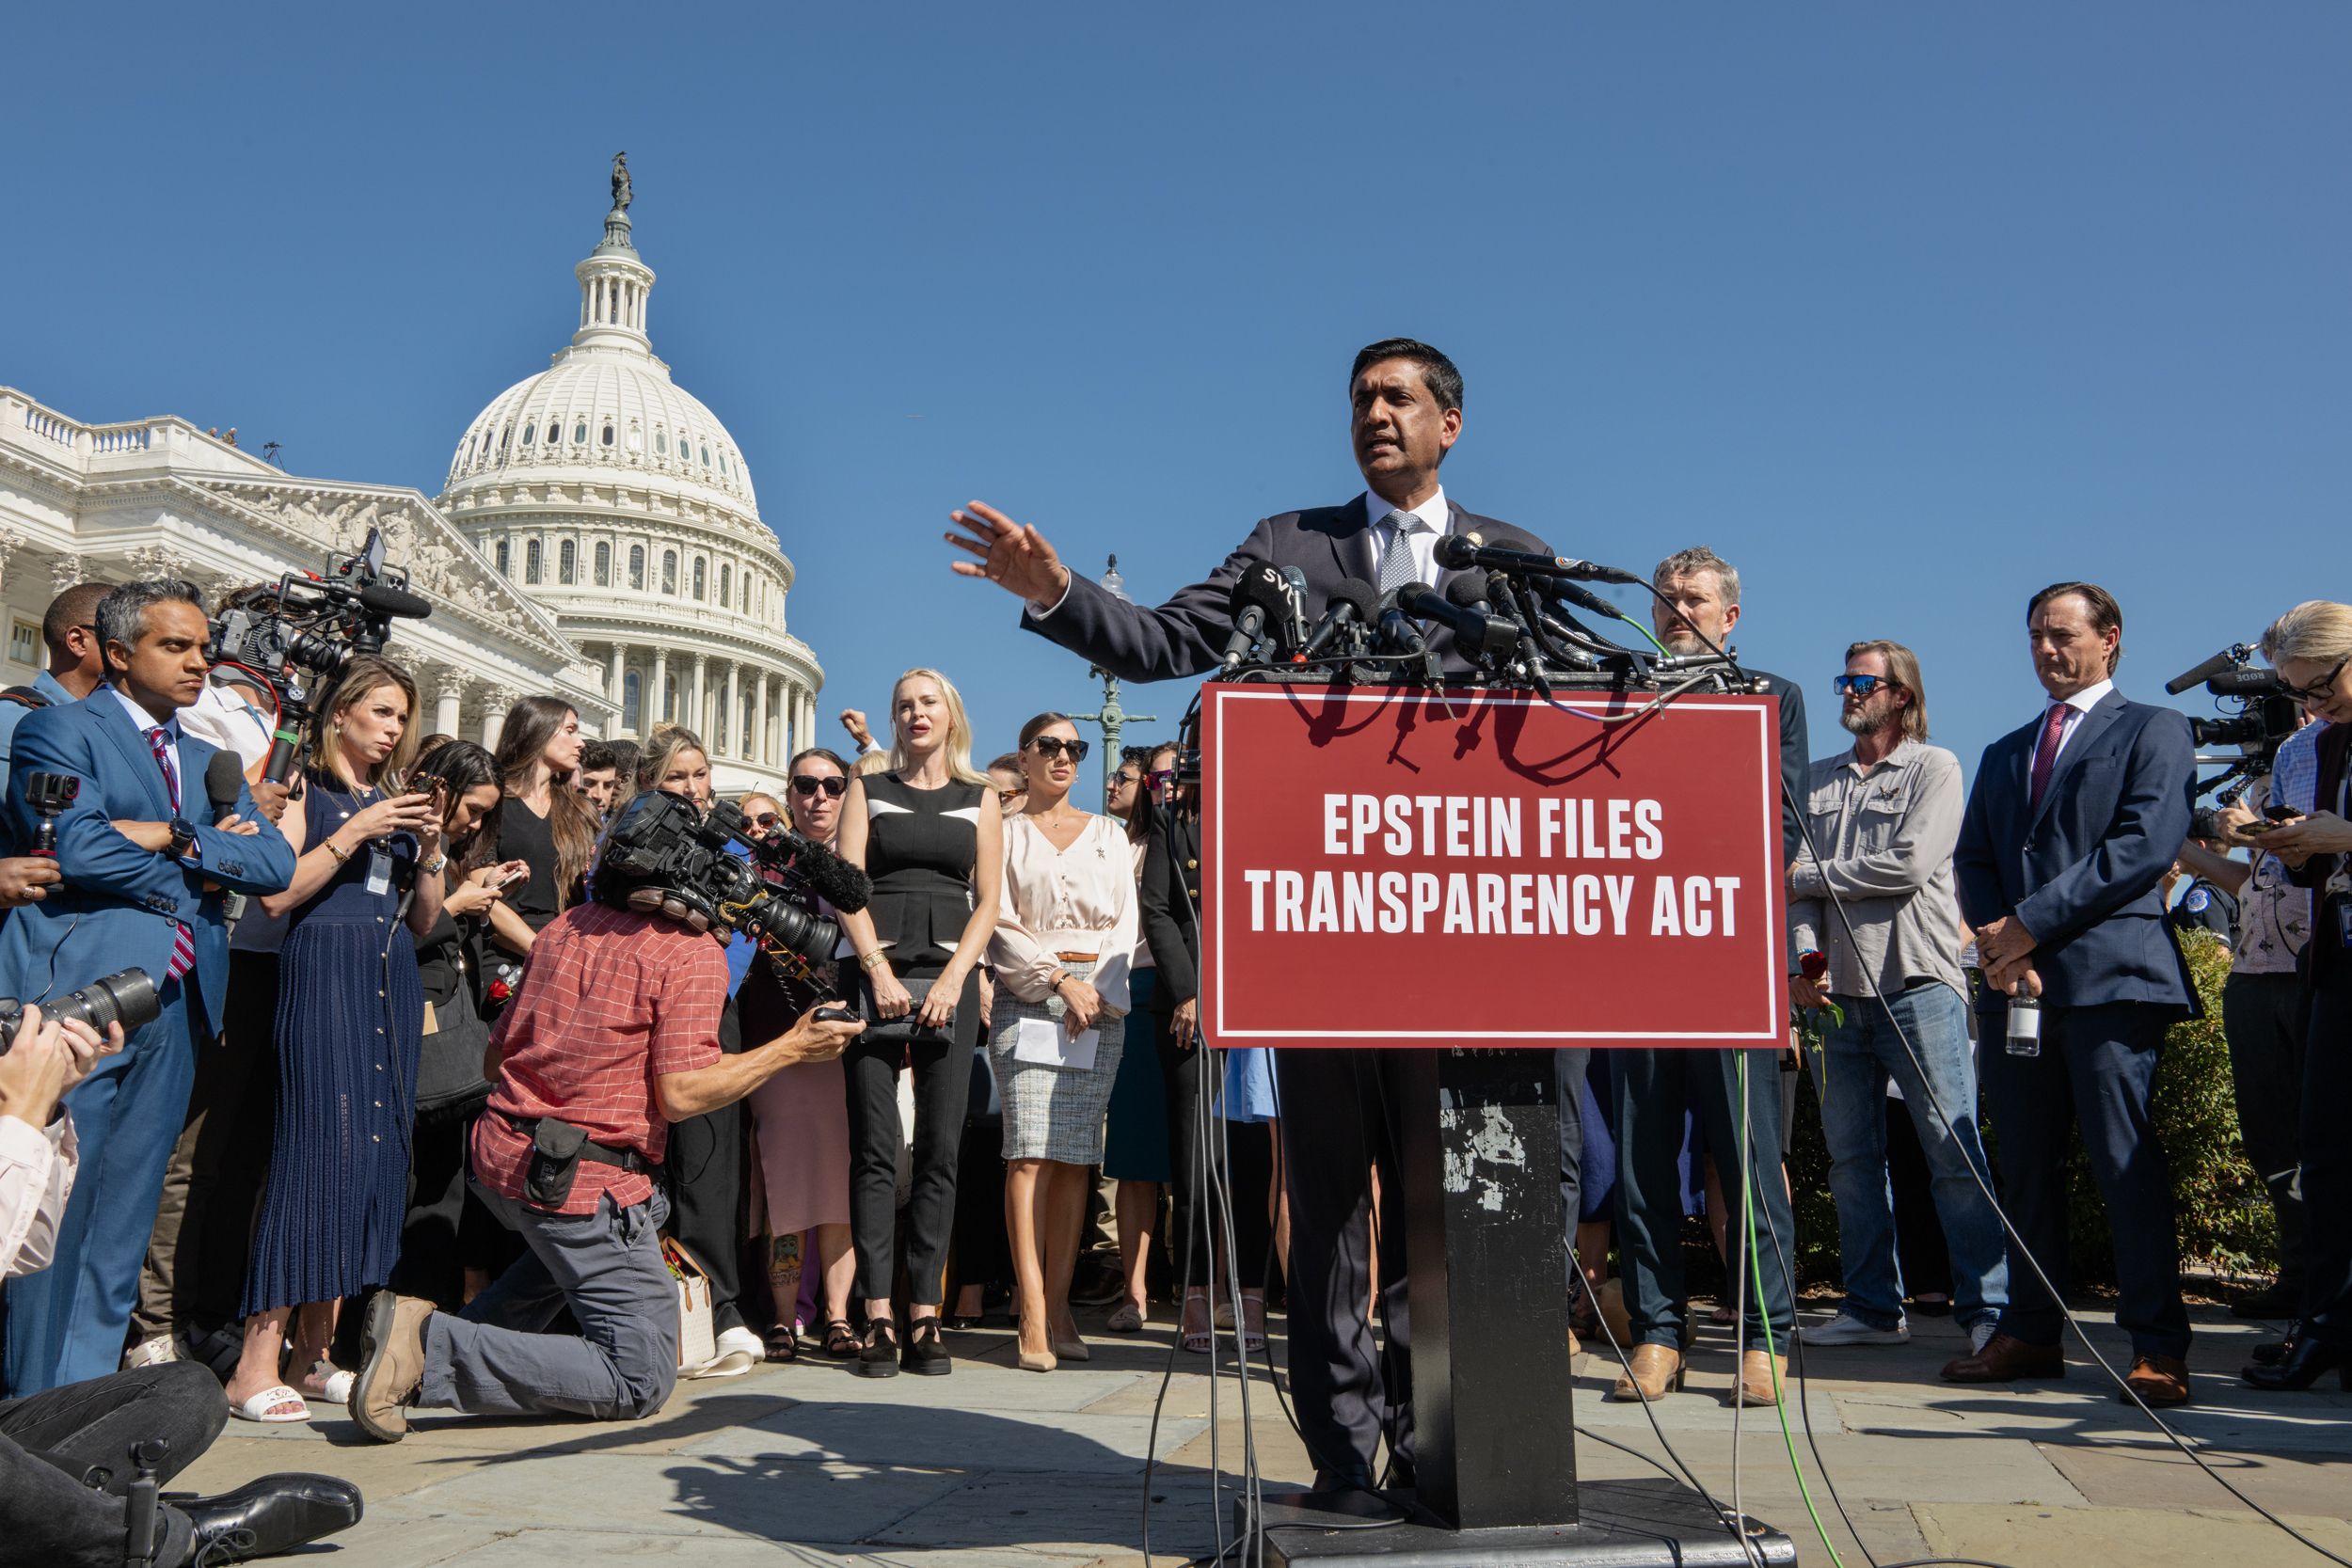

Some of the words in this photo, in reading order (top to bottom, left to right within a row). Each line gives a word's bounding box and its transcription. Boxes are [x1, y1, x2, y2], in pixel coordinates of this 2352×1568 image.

[1324, 793, 1522, 858] EPSTEIN
[1538, 798, 1663, 861] FILES
[1244, 869, 1635, 936] TRANSPARENCY
[1650, 876, 1740, 937] ACT
